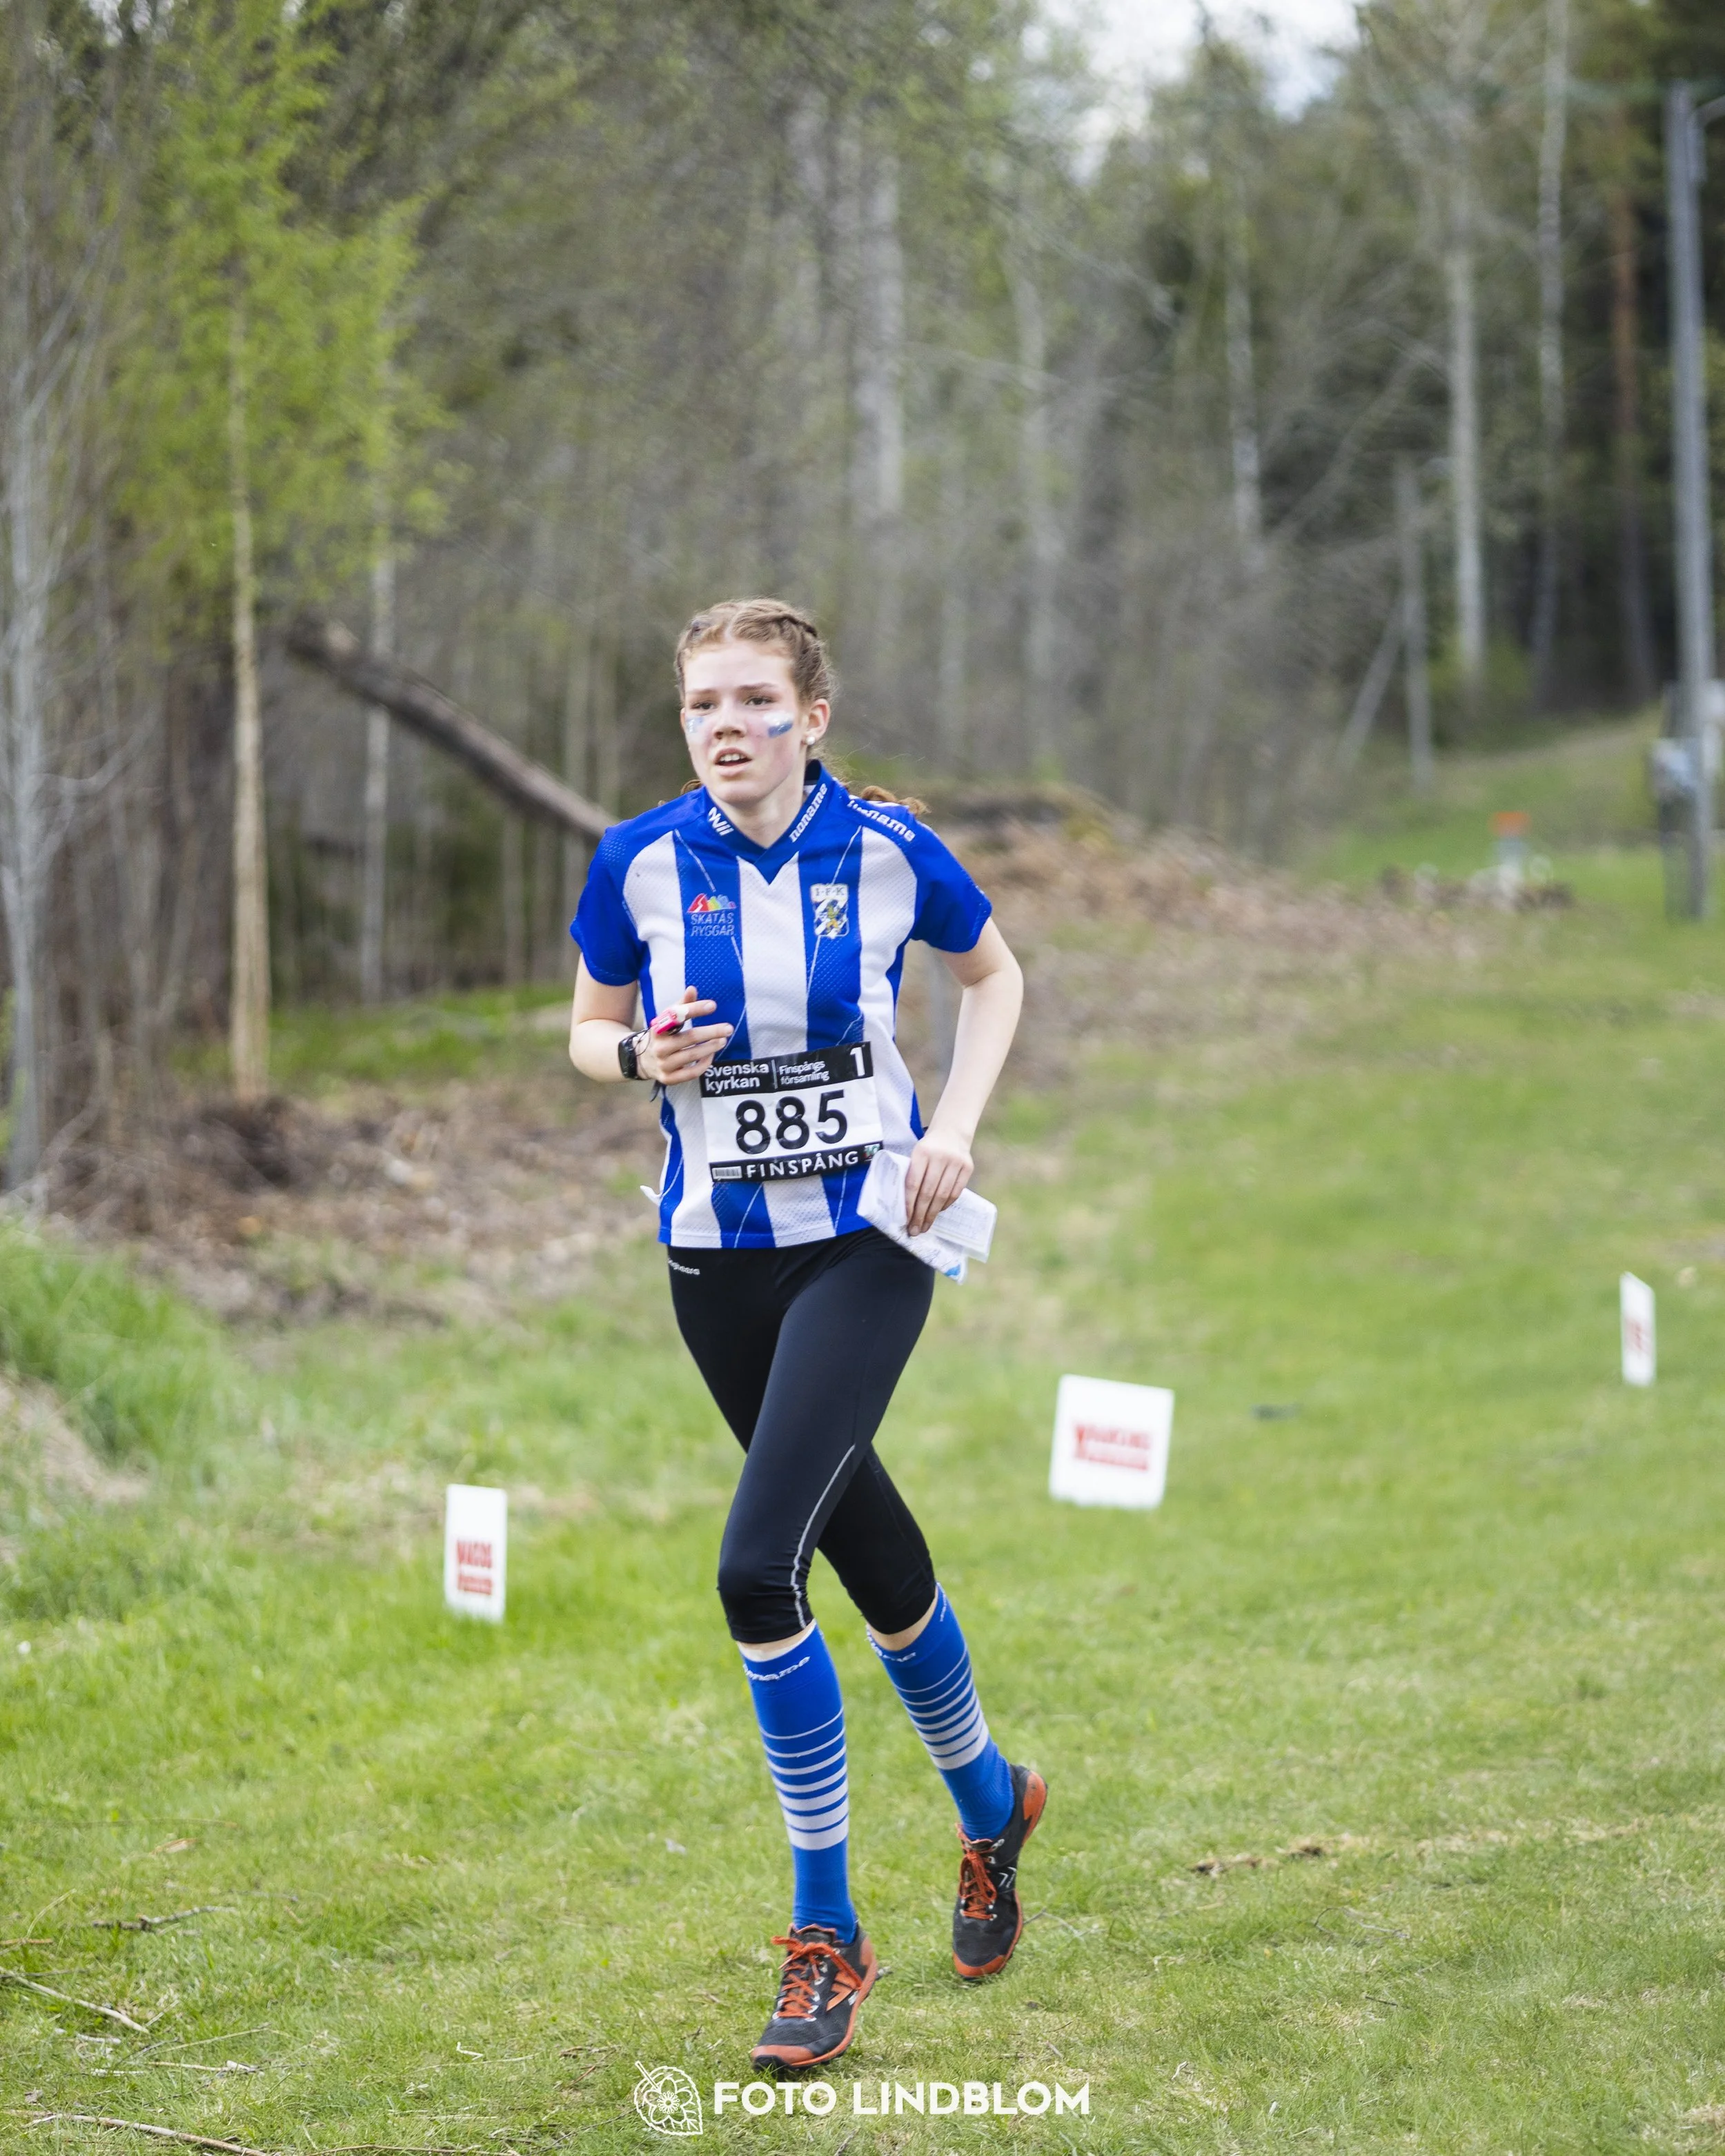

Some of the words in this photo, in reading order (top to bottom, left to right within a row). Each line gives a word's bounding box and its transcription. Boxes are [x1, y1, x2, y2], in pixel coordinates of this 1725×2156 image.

[789, 783, 828, 842] noname
[691, 924, 735, 936] RYGGAR
[704, 1062, 770, 1077] Svenska
[779, 1060, 826, 1075] Finspångs
[849, 1047, 865, 1076] 1
[705, 1076, 760, 1094] kyrkan
[780, 1071, 830, 1085] församling
[736, 1089, 848, 1155] 885
[747, 1150, 858, 1178] FINSPÅNG
